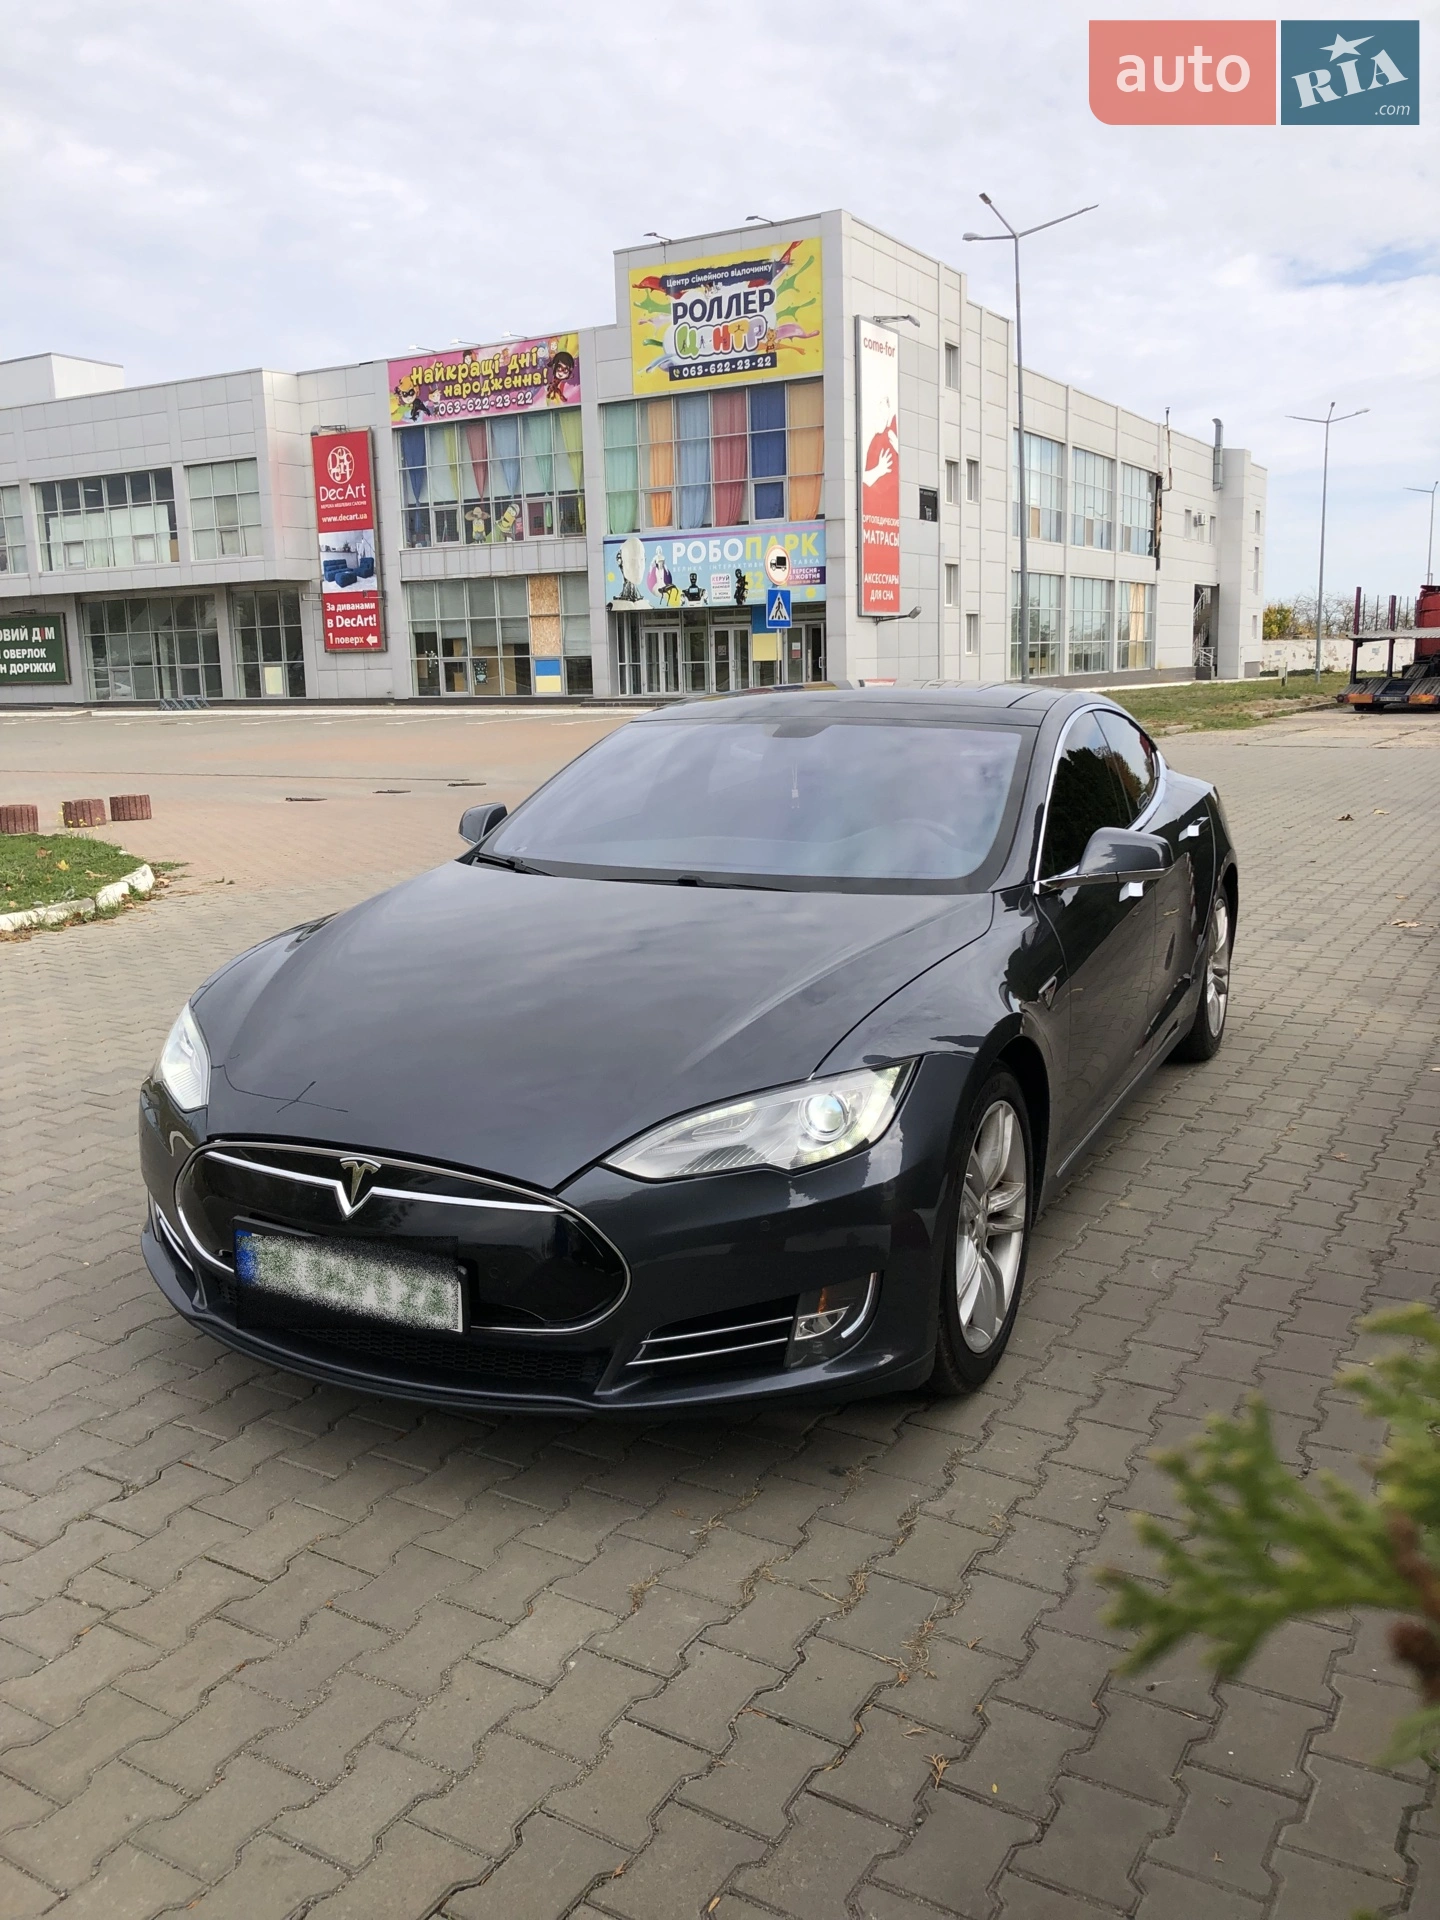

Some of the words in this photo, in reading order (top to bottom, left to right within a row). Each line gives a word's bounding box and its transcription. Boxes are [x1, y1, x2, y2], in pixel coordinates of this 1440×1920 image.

[666, 277, 690, 288] Центр
[691, 270, 729, 284] сімейного
[730, 263, 773, 277] відпочинку
[672, 288, 776, 325] РОЛЛЕР
[863, 337, 895, 358] come-for
[410, 353, 501, 385] Найкращі
[507, 346, 538, 375] дні
[682, 355, 772, 378] 063-622-23-22
[443, 368, 548, 398] народження!
[439, 391, 533, 415] 063-622-23-22
[321, 513, 368, 523] www.decart.ua
[863, 529, 900, 547] МАТРАСЫ
[709, 561, 764, 570] ІНТЕРАКТИВН
[864, 573, 900, 585] АКСЕССУАРЫ
[870, 589, 882, 603] ДЛЯ
[882, 590, 894, 601] СНА
[326, 602, 335, 612] За
[336, 602, 376, 613] диванами
[327, 618, 334, 628] в
[335, 614, 377, 628] DecArt!
[32, 627, 55, 643] ДІМ
[327, 632, 334, 645] 1
[335, 636, 364, 646] поверх
[3, 648, 47, 659] ОВЕРЛОК
[0, 663, 7, 674] Н
[9, 662, 56, 675] ДОРІЖКИ
